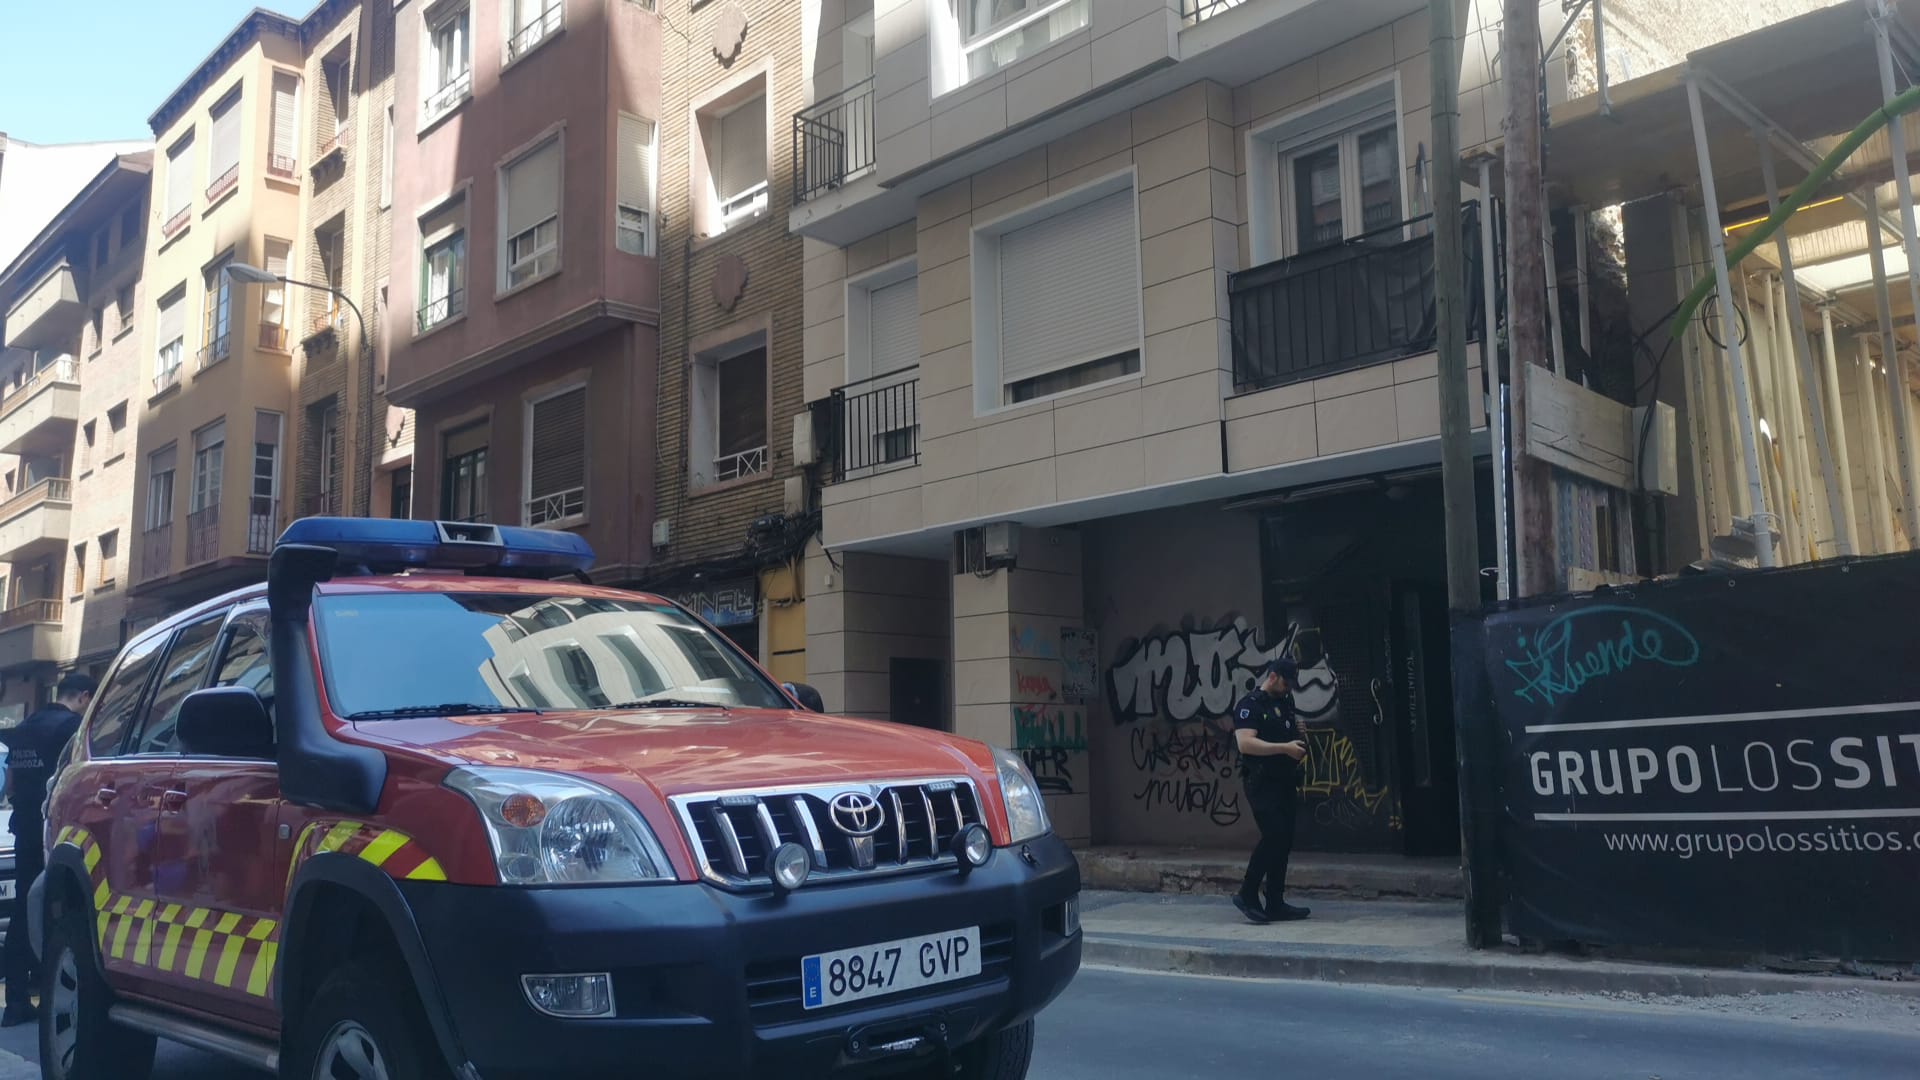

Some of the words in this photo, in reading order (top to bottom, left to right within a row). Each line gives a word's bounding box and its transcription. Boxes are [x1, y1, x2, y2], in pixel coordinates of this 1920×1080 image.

[810, 986, 817, 998] E
[829, 947, 901, 997] 8847
[920, 936, 969, 978] GVP
